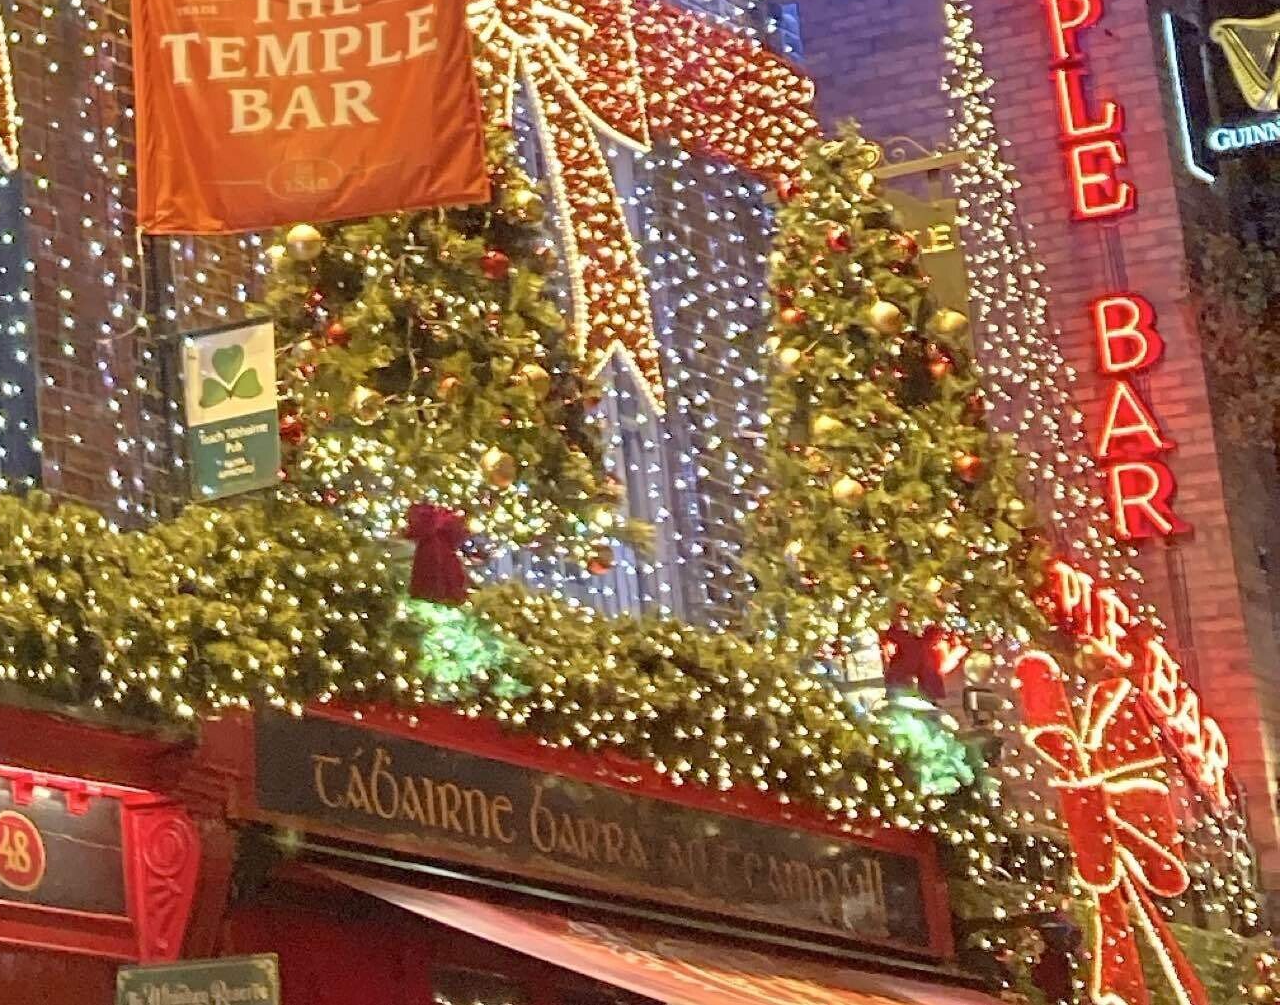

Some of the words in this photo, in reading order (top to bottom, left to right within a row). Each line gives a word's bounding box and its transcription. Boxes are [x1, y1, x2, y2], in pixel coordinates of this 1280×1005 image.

[160, 4, 439, 85] TEMPLE
[228, 79, 381, 135] BAR
[1207, 113, 1280, 152] GUINN
[1090, 292, 1194, 541] BAR
